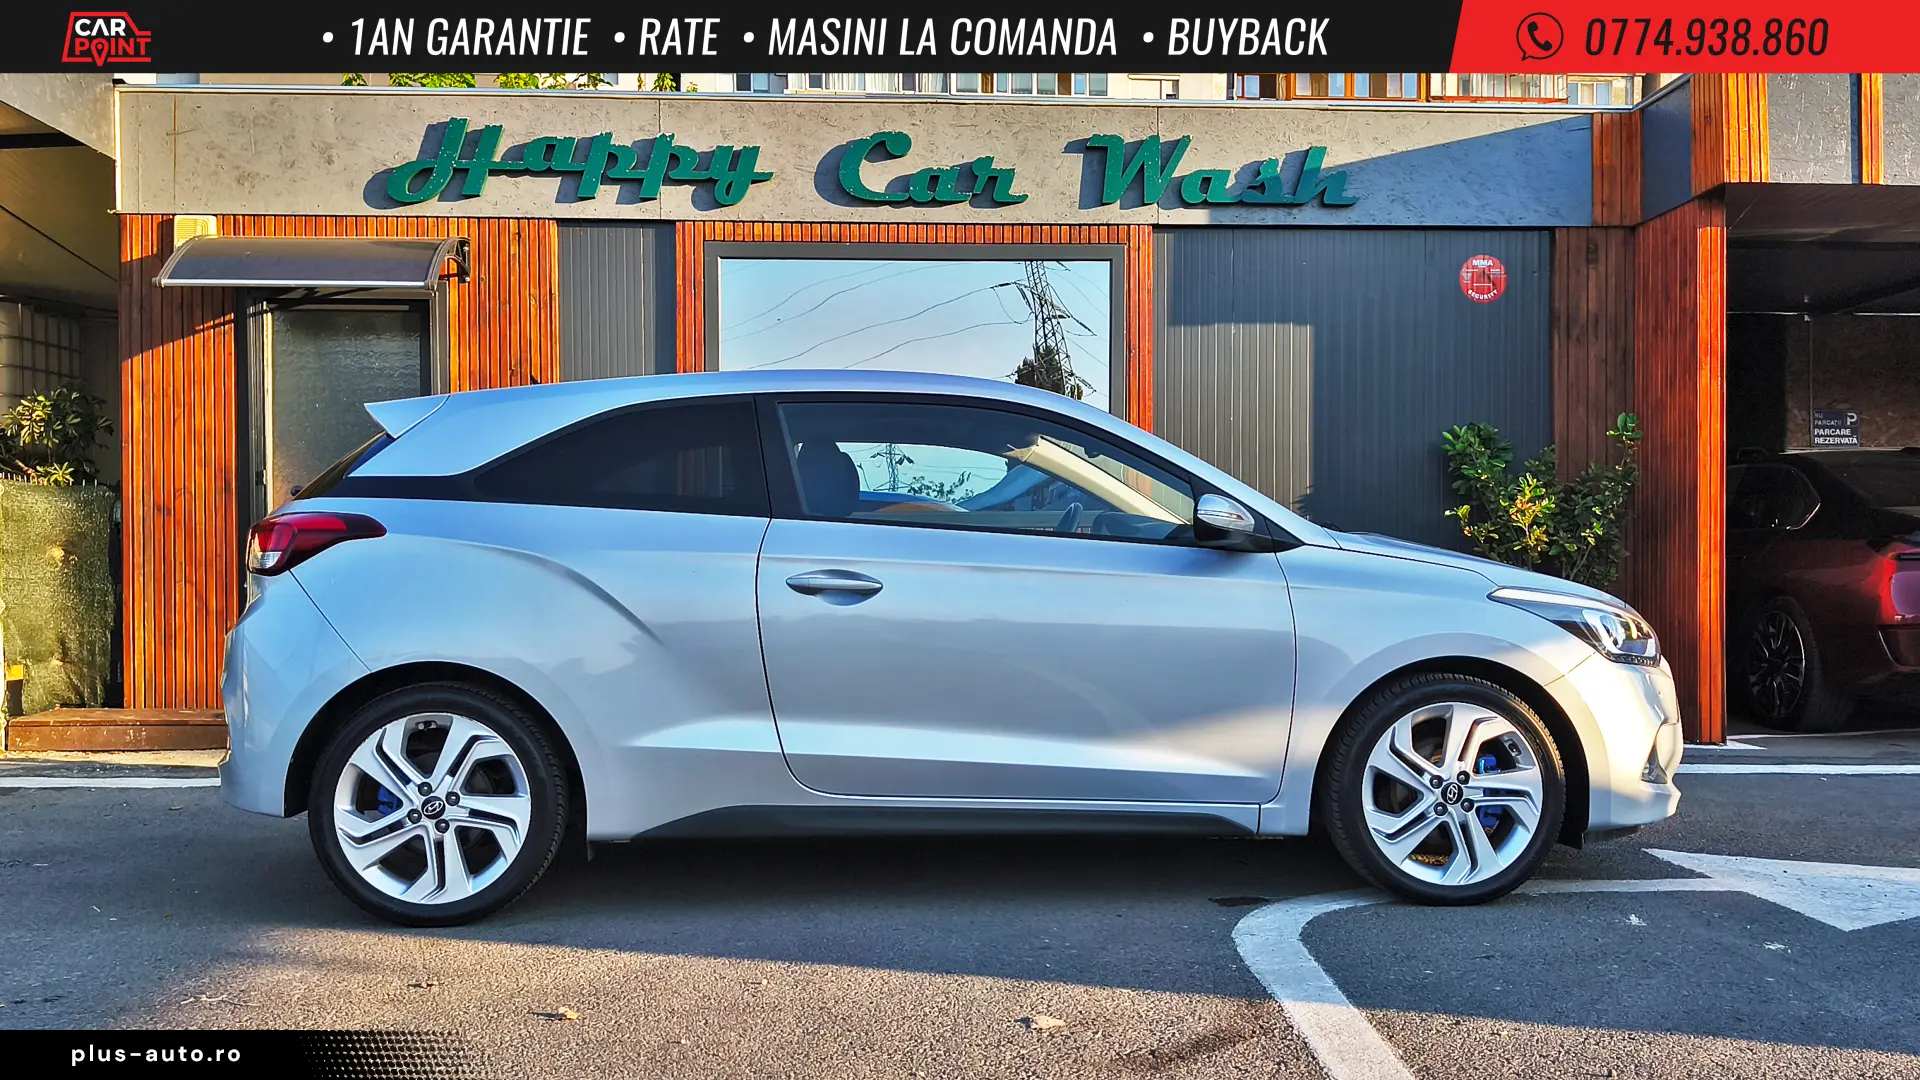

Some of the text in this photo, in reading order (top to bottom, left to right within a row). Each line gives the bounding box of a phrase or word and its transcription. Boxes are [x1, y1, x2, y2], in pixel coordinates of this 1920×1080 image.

[386, 117, 1361, 208] Happy Car Wash
[1468, 289, 1498, 299] SECURITY
[1814, 435, 1858, 444] REZERVATĂ
